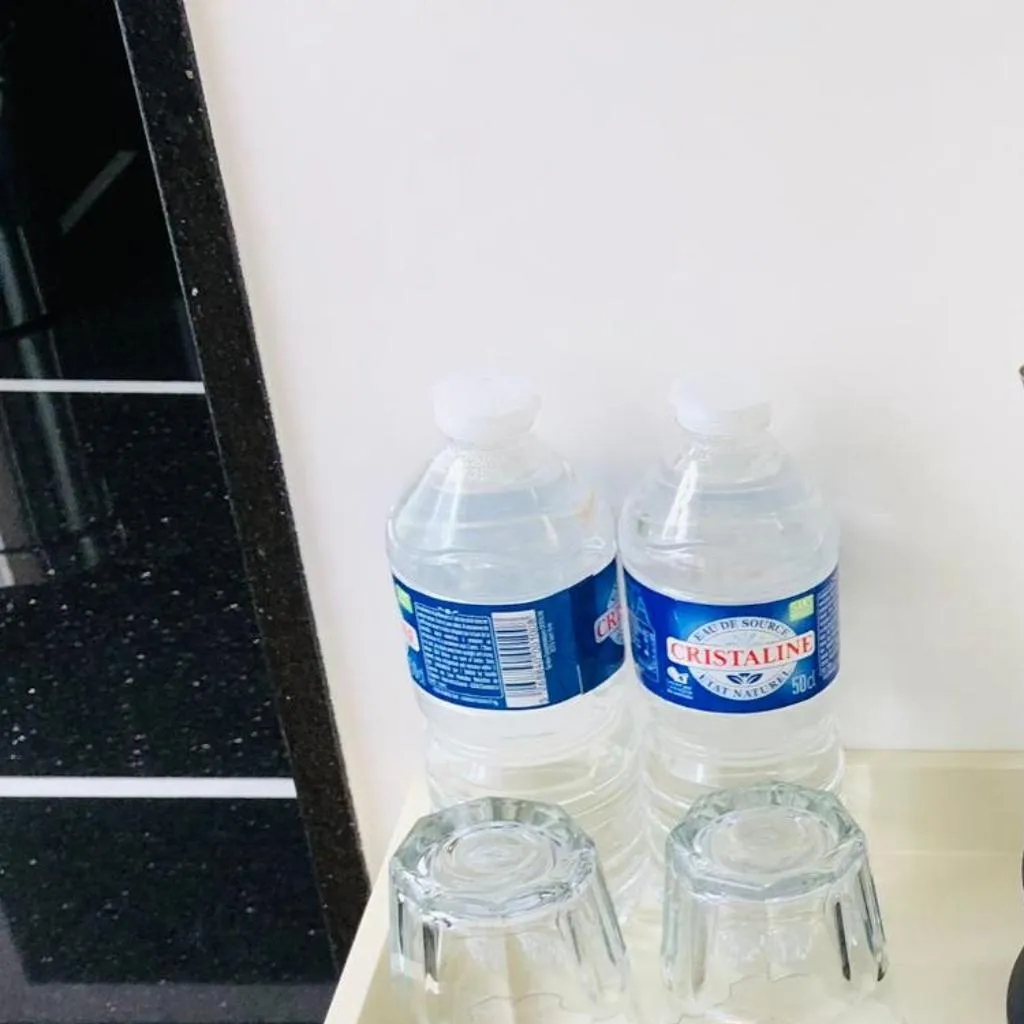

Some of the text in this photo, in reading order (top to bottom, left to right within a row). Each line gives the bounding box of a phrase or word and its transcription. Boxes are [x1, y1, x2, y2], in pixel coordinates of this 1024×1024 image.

[694, 618, 790, 641] EAU DE SOURCE
[670, 635, 814, 667] CRISTALINE
